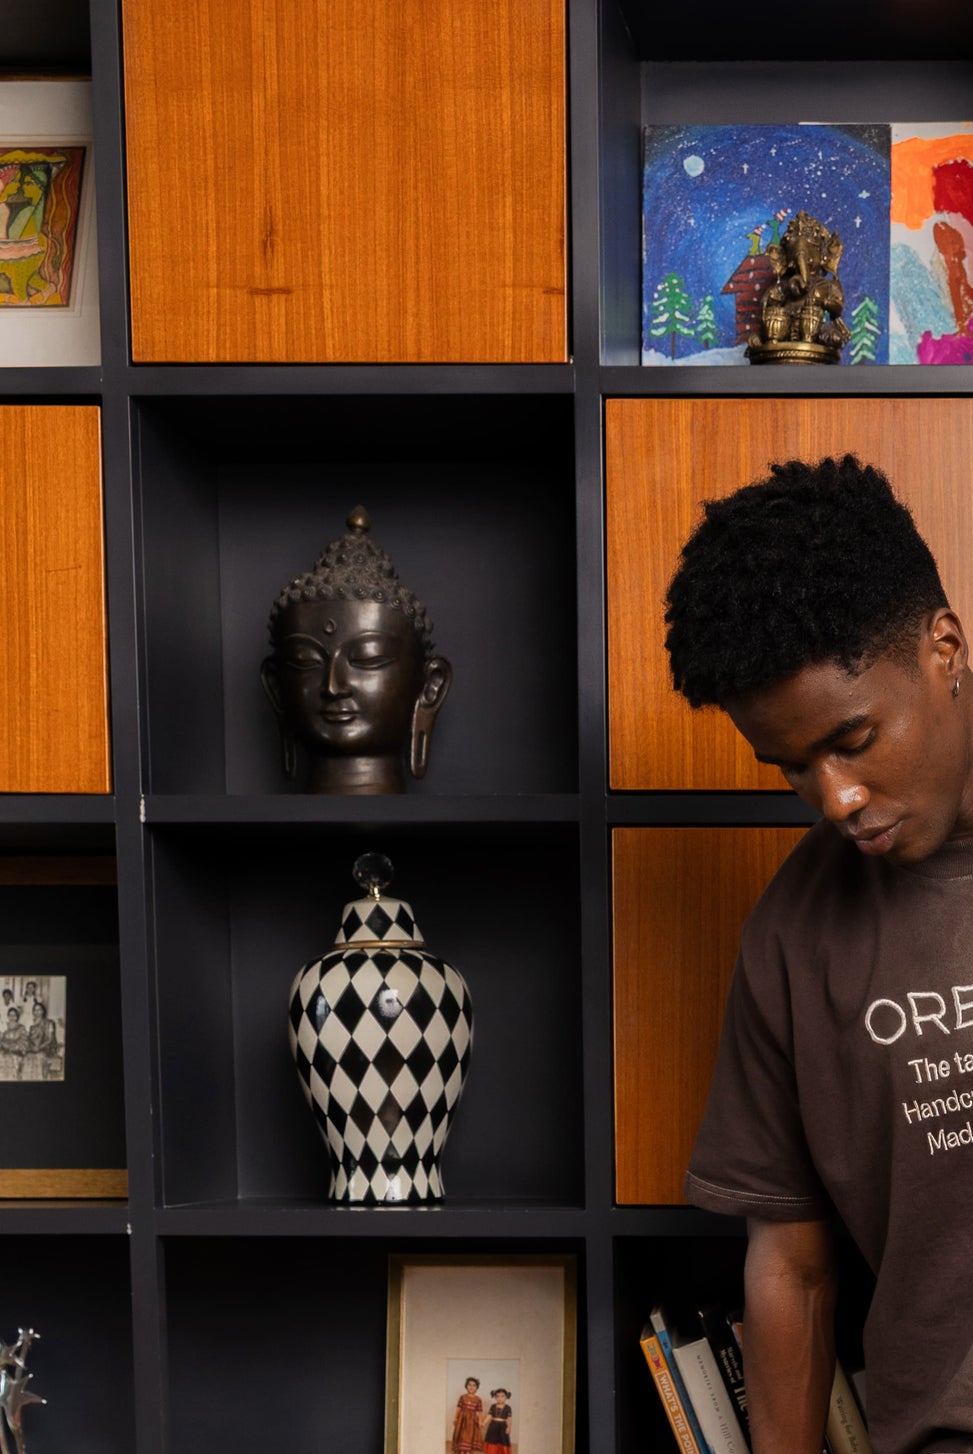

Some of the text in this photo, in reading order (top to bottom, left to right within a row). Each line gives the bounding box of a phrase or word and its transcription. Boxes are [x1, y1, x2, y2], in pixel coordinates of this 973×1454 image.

[908, 1058, 950, 1084] The
[659, 1374, 680, 1413] WHAT'S
[671, 1414, 687, 1432] THE
[696, 1354, 711, 1390] MEMORIES
[707, 1393, 721, 1412] FROM
[718, 1423, 733, 1440] Hill
